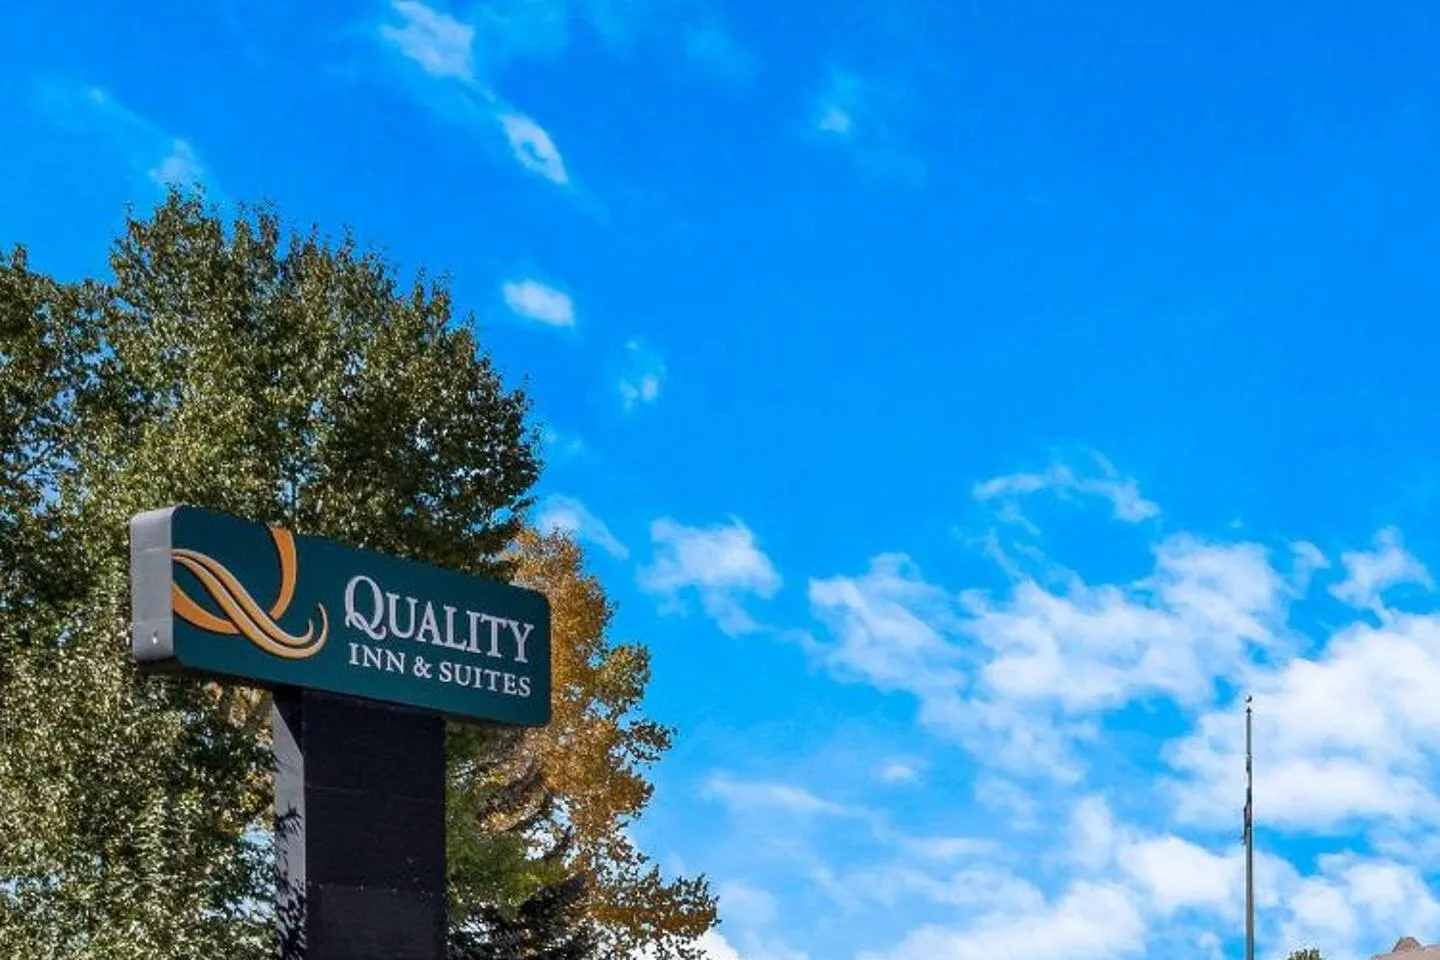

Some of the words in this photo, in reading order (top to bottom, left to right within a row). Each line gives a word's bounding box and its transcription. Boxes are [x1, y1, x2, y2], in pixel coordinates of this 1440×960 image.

[344, 575, 534, 663] QUALITY
[349, 643, 405, 675] INN
[414, 656, 432, 678] &
[439, 661, 531, 698] SUITES
